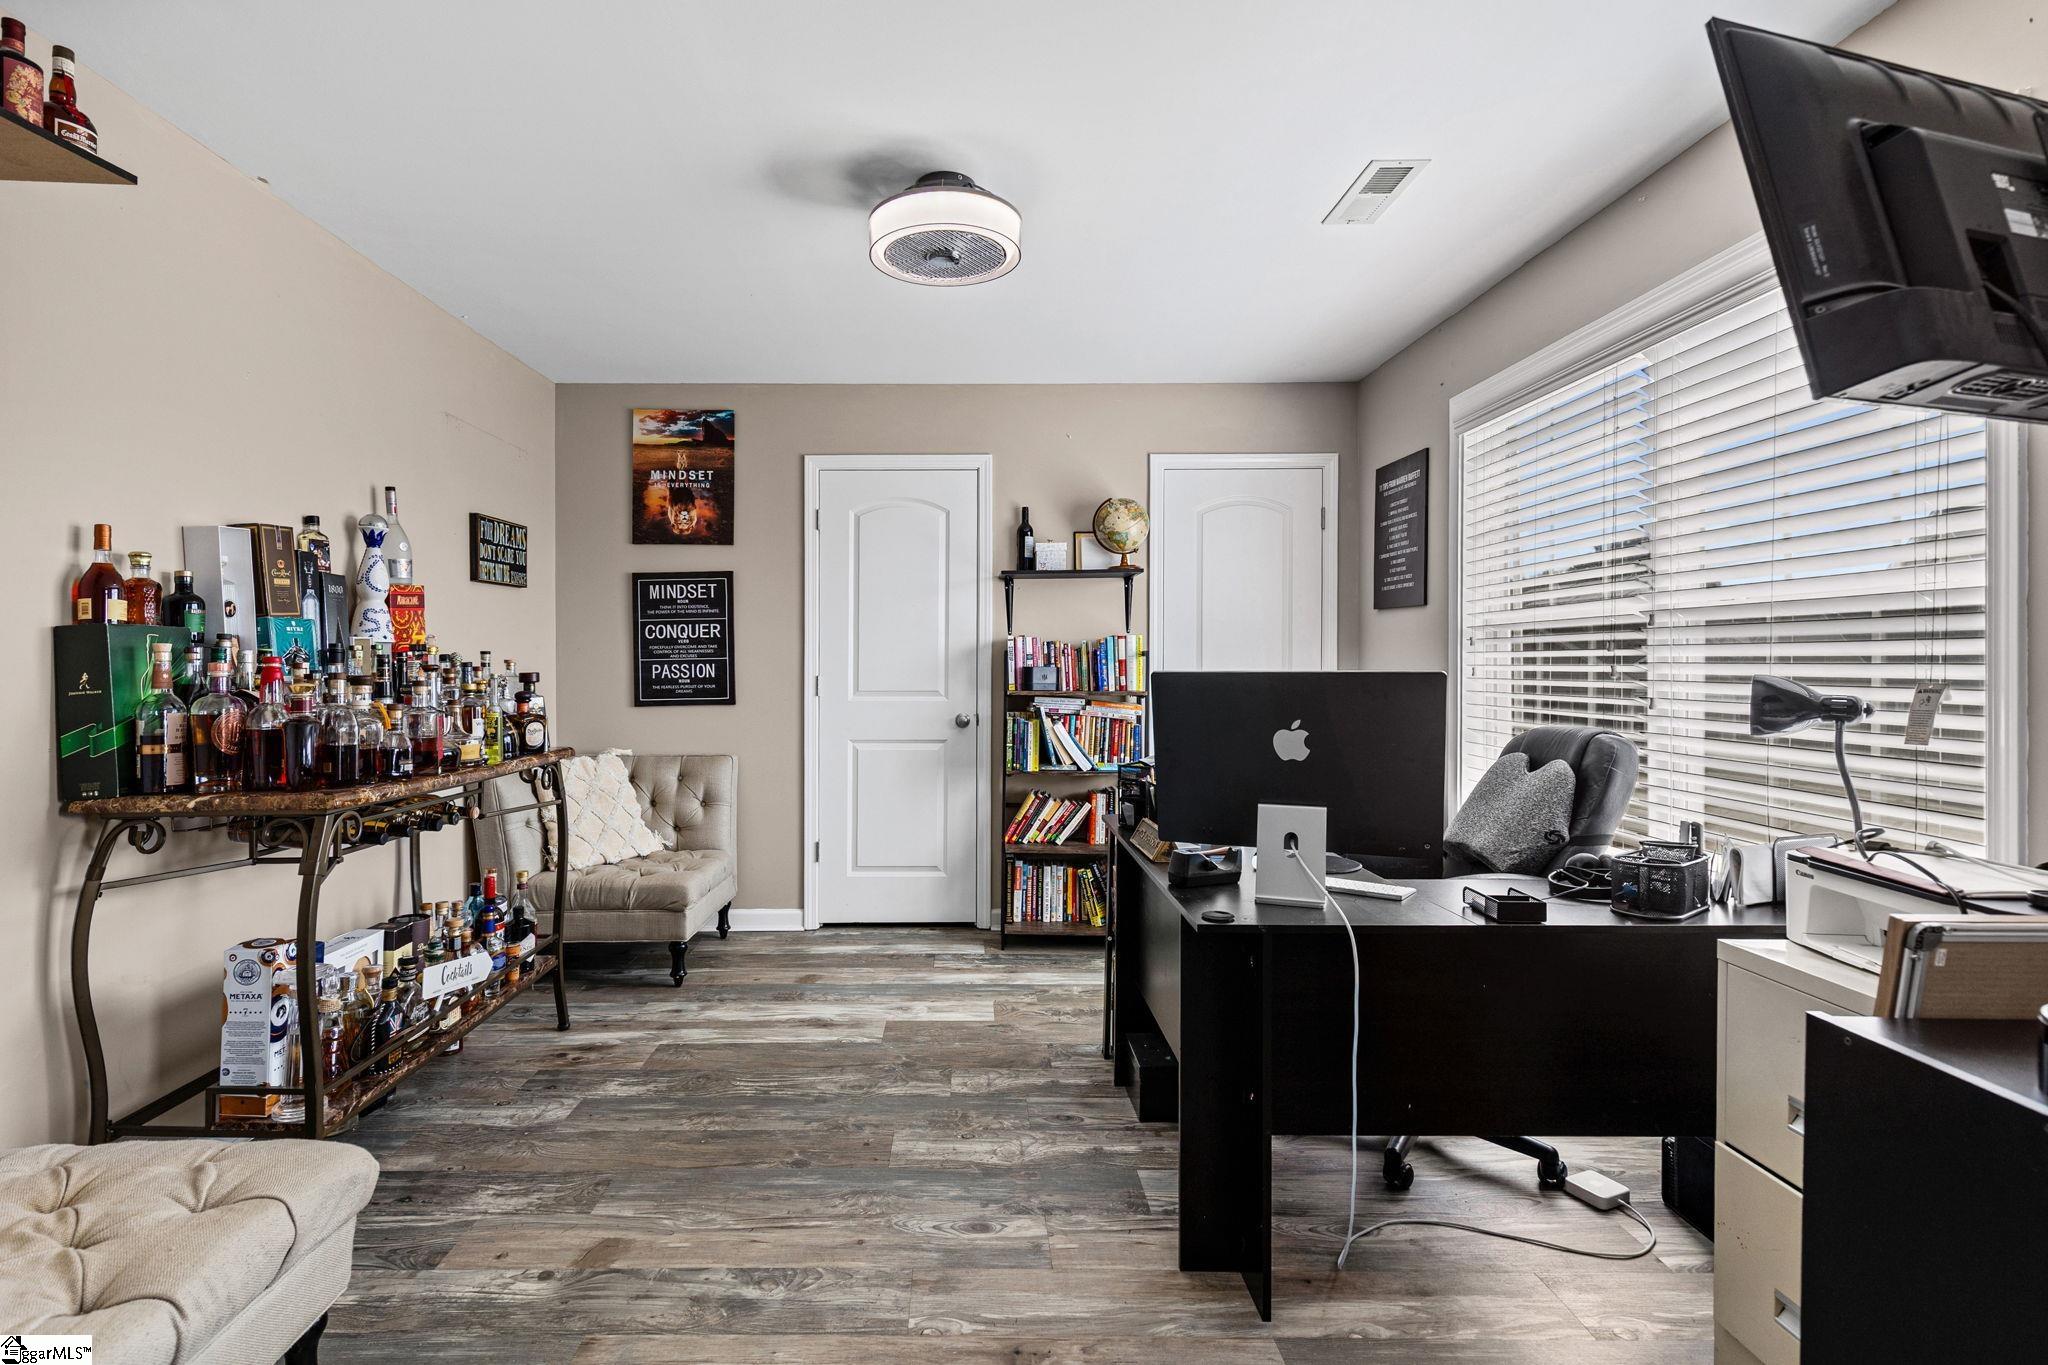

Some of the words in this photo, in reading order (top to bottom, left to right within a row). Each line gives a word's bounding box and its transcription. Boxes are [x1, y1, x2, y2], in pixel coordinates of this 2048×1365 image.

[650, 470, 714, 480] MINDSET
[494, 521, 527, 550] DREAMS
[497, 546, 515, 564] SCARE
[516, 550, 526, 567] YOU
[328, 585, 344, 594] 1800
[649, 584, 717, 599] MINDSET
[645, 624, 720, 639] CONQUER
[652, 663, 715, 679] PASSION
[1795, 869, 1814, 879] Canon
[441, 961, 473, 986] Cocktails
